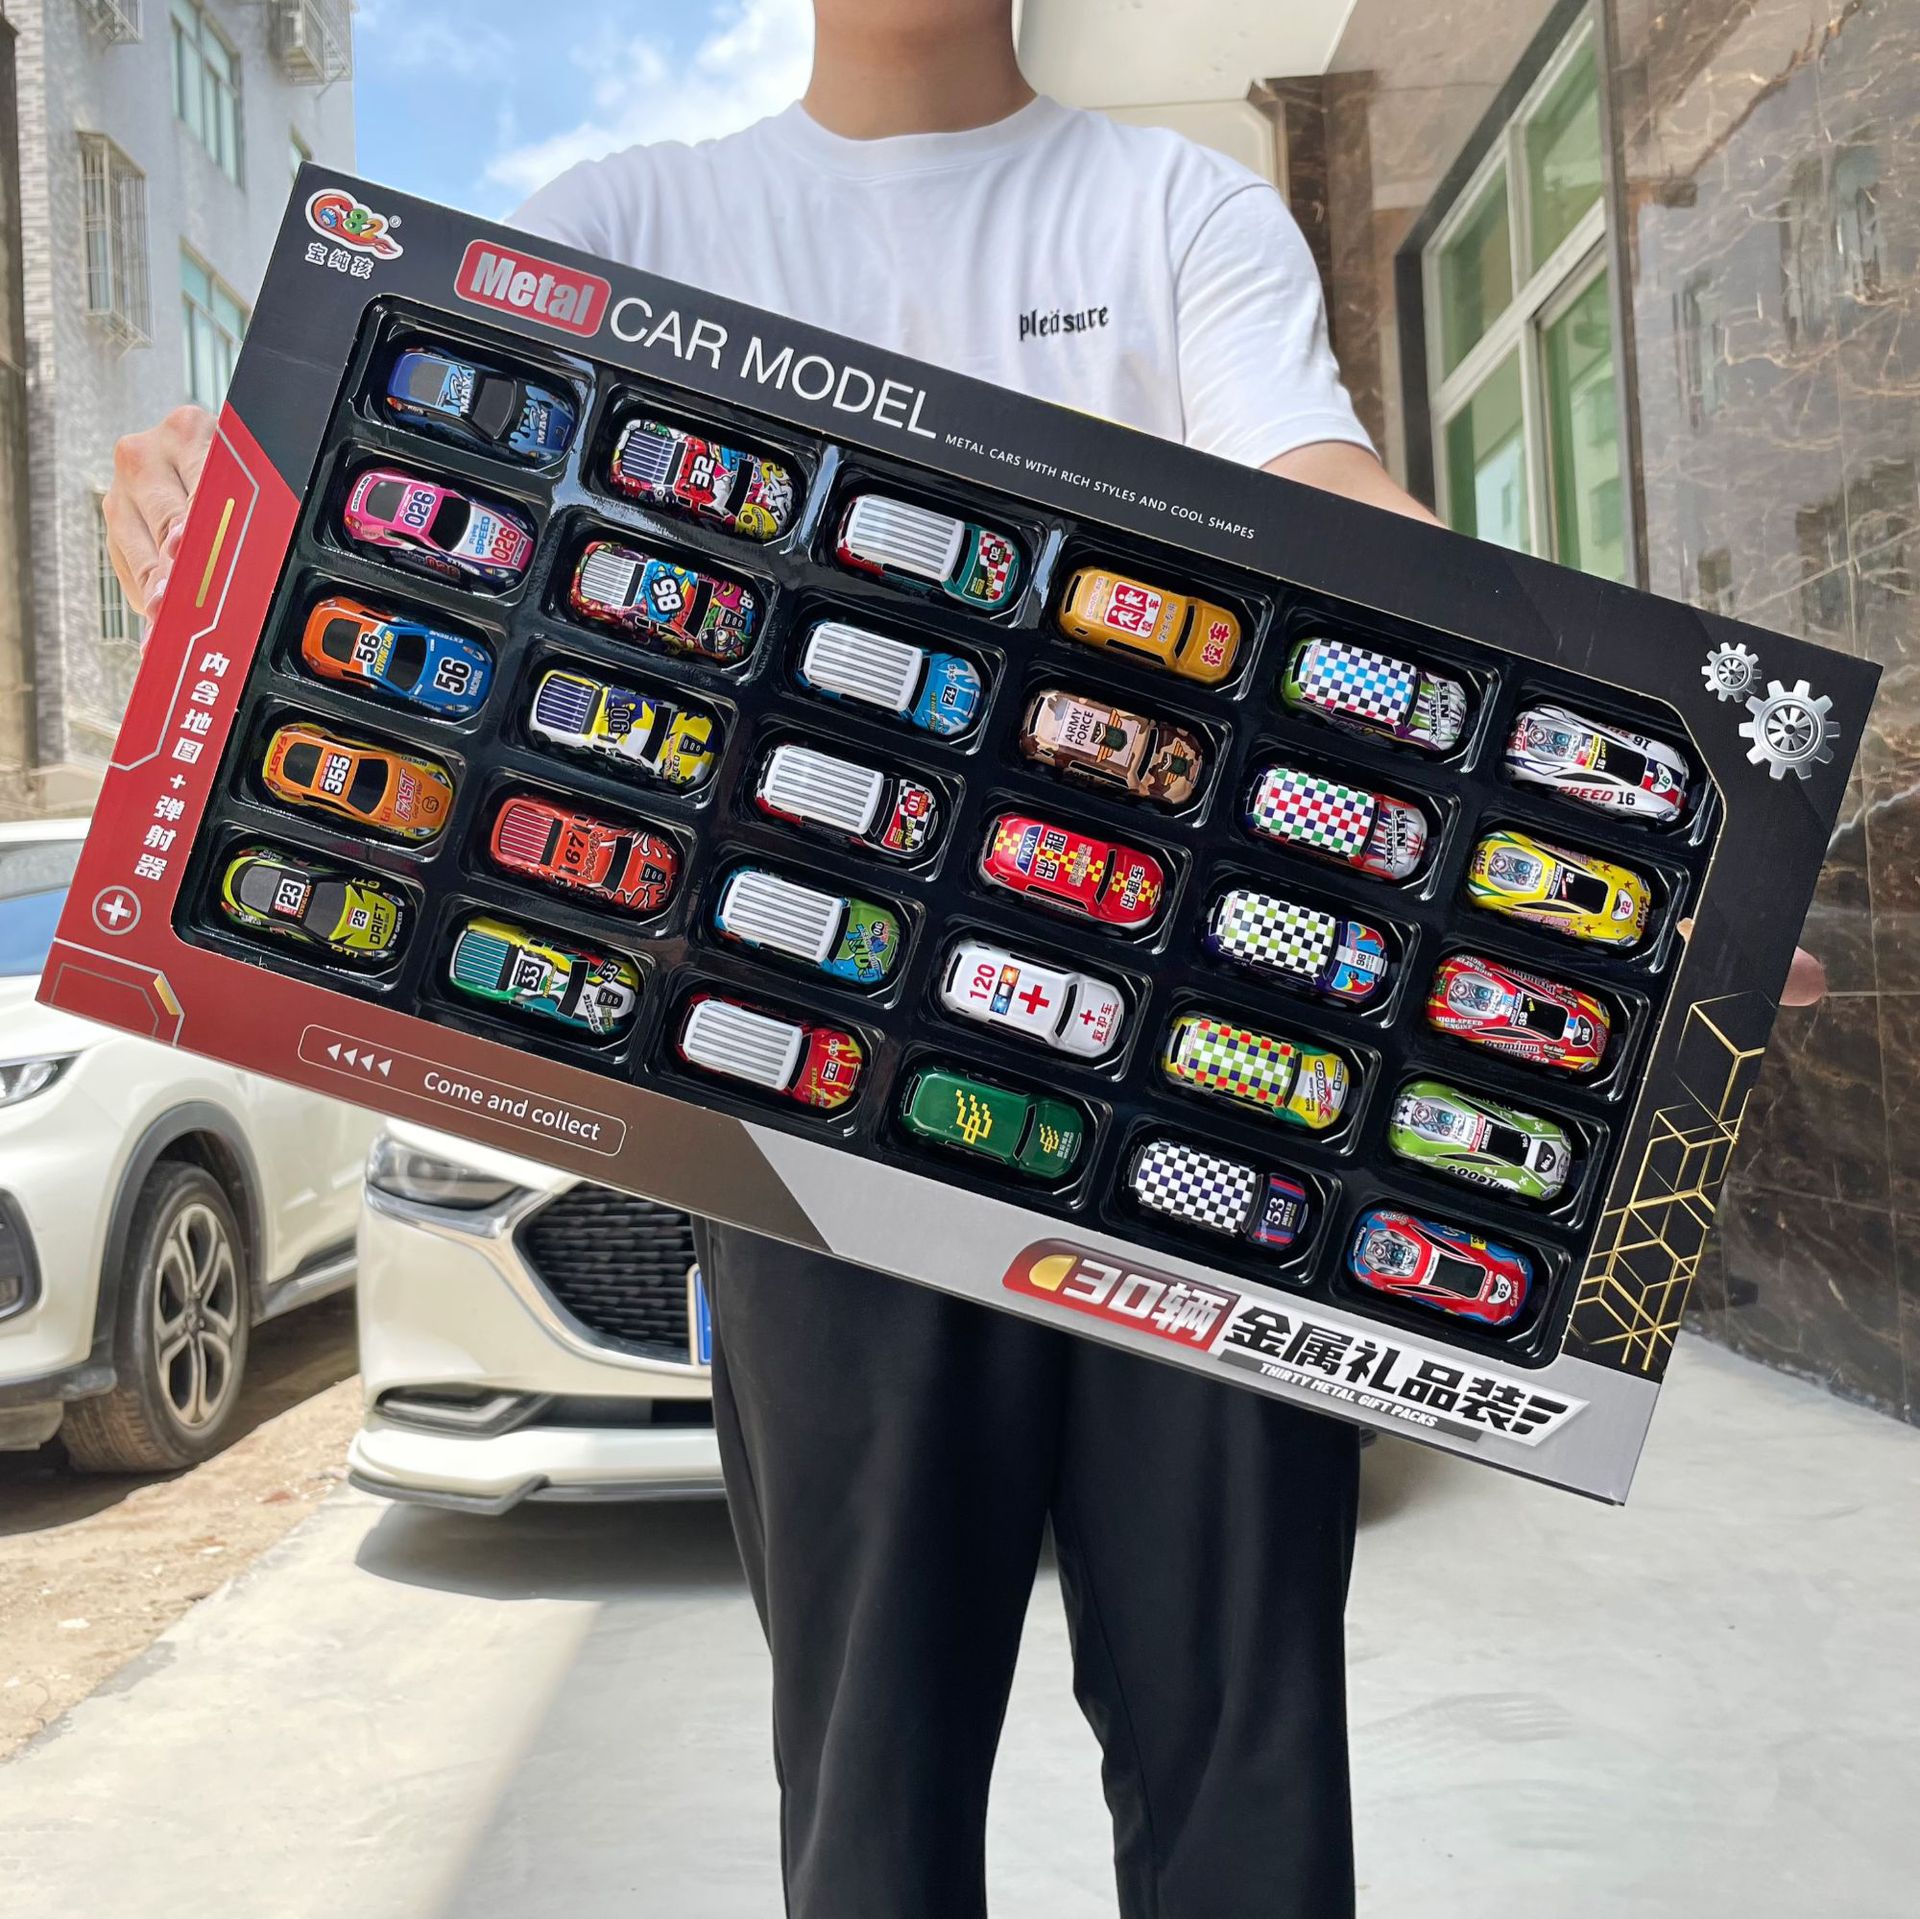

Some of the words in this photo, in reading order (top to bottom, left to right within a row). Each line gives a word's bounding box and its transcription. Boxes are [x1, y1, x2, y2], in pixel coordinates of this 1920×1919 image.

[305, 242, 374, 280] 宝纯孩
[470, 251, 594, 325] Metal
[609, 297, 727, 370] CAR
[739, 336, 938, 441] MODEL
[458, 375, 474, 413] MAX
[689, 454, 715, 487] 32
[945, 433, 986, 455] METAL
[988, 447, 1021, 466] CARS
[1024, 458, 1057, 477] WITH
[1060, 469, 1090, 488] RICH
[1093, 479, 1136, 502] STYLES
[1139, 494, 1167, 512] AND
[1170, 503, 1205, 523] COOL
[1207, 515, 1255, 539] SHAPES
[404, 490, 435, 527] 026
[475, 515, 489, 554] SPEED
[490, 527, 517, 561] 026
[989, 545, 1001, 561] 02
[653, 578, 681, 611] 85
[1085, 591, 1099, 618] SCHOOL
[1094, 576, 1104, 590] BUS
[1141, 597, 1159, 632] 校车
[355, 632, 380, 663] 56
[374, 647, 390, 675] FLYING
[382, 631, 394, 648] CAR
[429, 629, 463, 643] EXTREME
[1200, 619, 1231, 666] 校车
[435, 658, 470, 693] 56
[468, 669, 483, 696] RACING
[172, 651, 230, 764] 内含地图
[943, 687, 956, 703] 74
[610, 706, 631, 733] 90
[1063, 707, 1082, 742] ARMY
[1074, 710, 1093, 745] FORCE
[268, 734, 288, 775] FAST
[1631, 735, 1651, 750] 16
[326, 755, 350, 793] 355
[1596, 758, 1606, 770] 16
[1655, 774, 1670, 789] 16
[395, 768, 415, 819] FAST
[907, 794, 920, 811] 01
[1559, 784, 1613, 803] SPEED
[1617, 791, 1636, 806] 16
[133, 795, 186, 881] 弹射器
[564, 833, 586, 865] 67
[1019, 833, 1036, 859] TAXI
[1035, 829, 1067, 880] 出租
[279, 882, 301, 906] 23
[1120, 863, 1145, 909] 出租车
[1565, 871, 1574, 883] 22
[352, 909, 367, 926] 23
[368, 902, 386, 944] DRIFT
[1620, 899, 1631, 914] 22
[387, 932, 398, 947] NEW
[394, 911, 403, 932] SPEED
[873, 921, 883, 934] 06
[520, 964, 541, 988] 33
[600, 962, 619, 981] 33
[968, 962, 996, 1001] 120
[1091, 1002, 1112, 1041] 救护车
[1483, 1038, 1539, 1054] Premium
[423, 1071, 484, 1105] Come
[487, 1092, 529, 1119] and
[531, 1107, 601, 1141] collect
[1540, 1154, 1552, 1169] No.1
[1265, 1196, 1286, 1224] 53
[1497, 1282, 1509, 1298] 62
[1224, 1307, 1521, 1433] 金属礼品装
[1259, 1362, 1310, 1387] THIRTY
[1310, 1379, 1355, 1402] METAL
[1357, 1394, 1391, 1413] GIFT
[1390, 1404, 1438, 1428] PACKS
